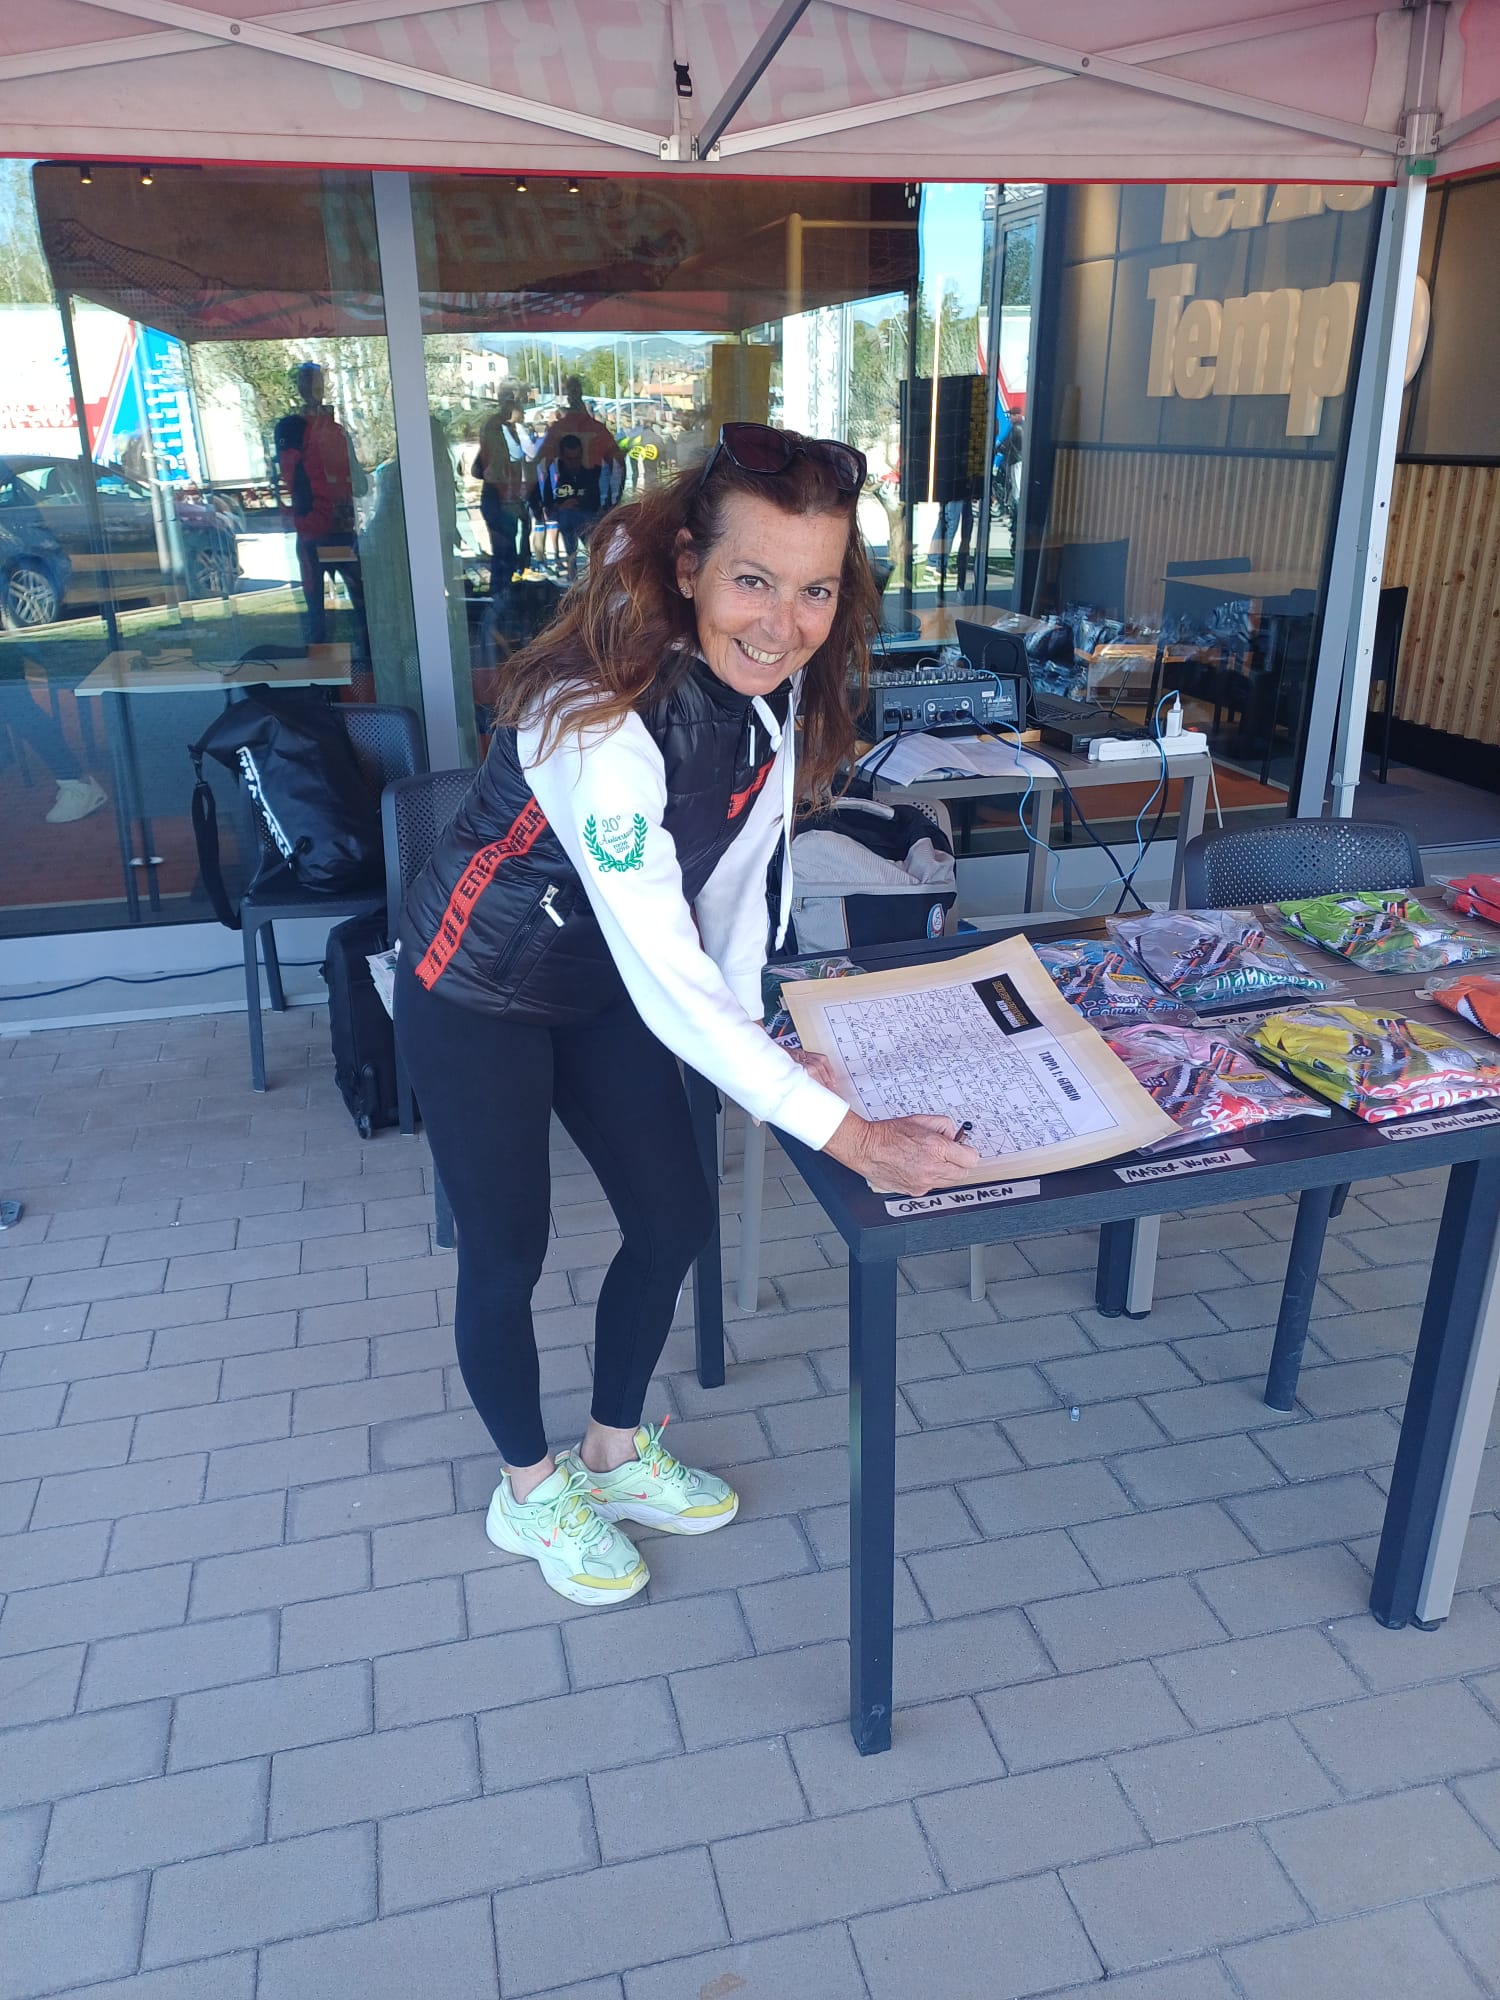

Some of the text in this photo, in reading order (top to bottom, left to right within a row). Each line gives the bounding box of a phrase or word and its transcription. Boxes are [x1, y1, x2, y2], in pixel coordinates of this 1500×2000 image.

[1039, 1051, 1061, 1071] TAPPA
[1126, 1153, 1232, 1180] MASTER WOMEN
[898, 1187, 1014, 1213] OPEN WOMEN
